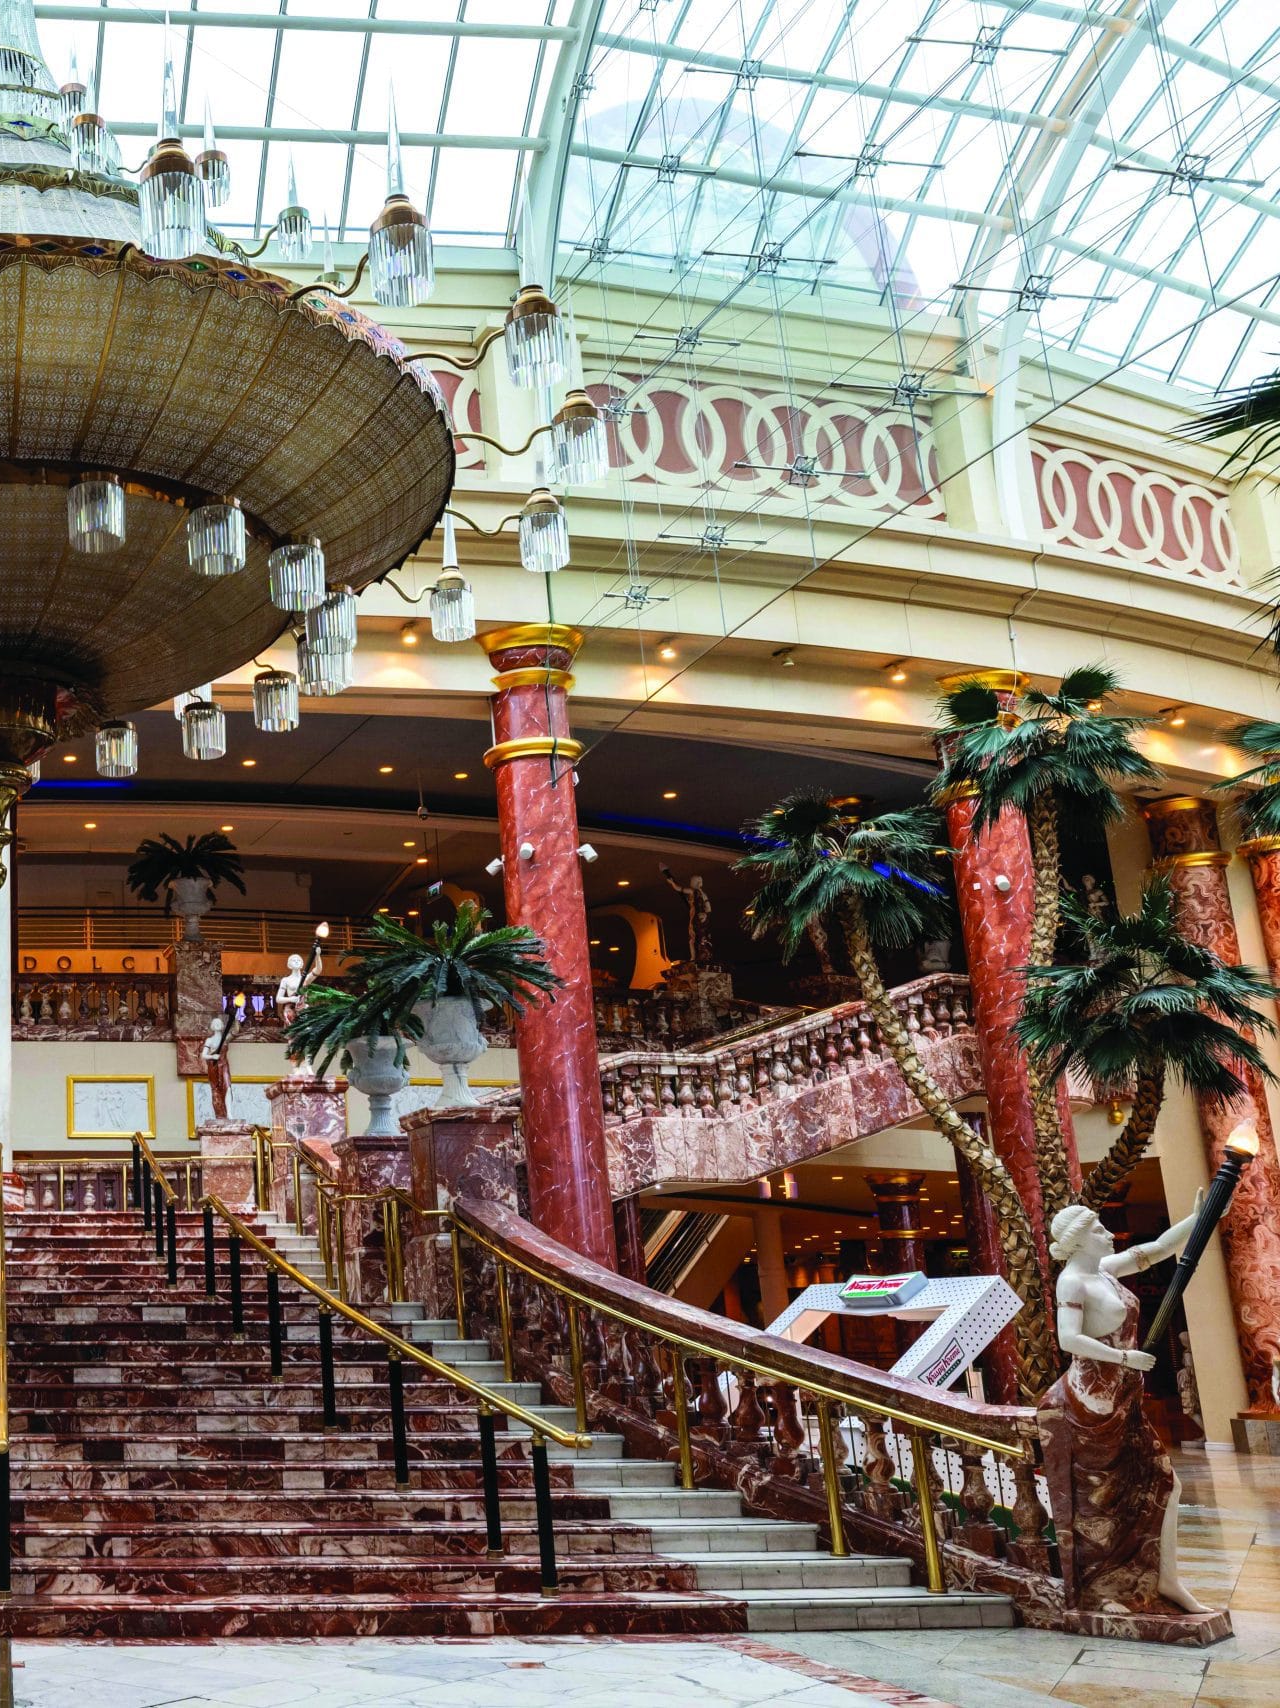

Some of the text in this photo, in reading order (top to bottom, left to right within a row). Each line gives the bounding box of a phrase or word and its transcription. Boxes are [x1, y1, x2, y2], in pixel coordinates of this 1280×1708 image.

[23, 955, 162, 971] DOLCI
[925, 1361, 946, 1385] Krispy
[941, 1344, 961, 1368] Kreme
